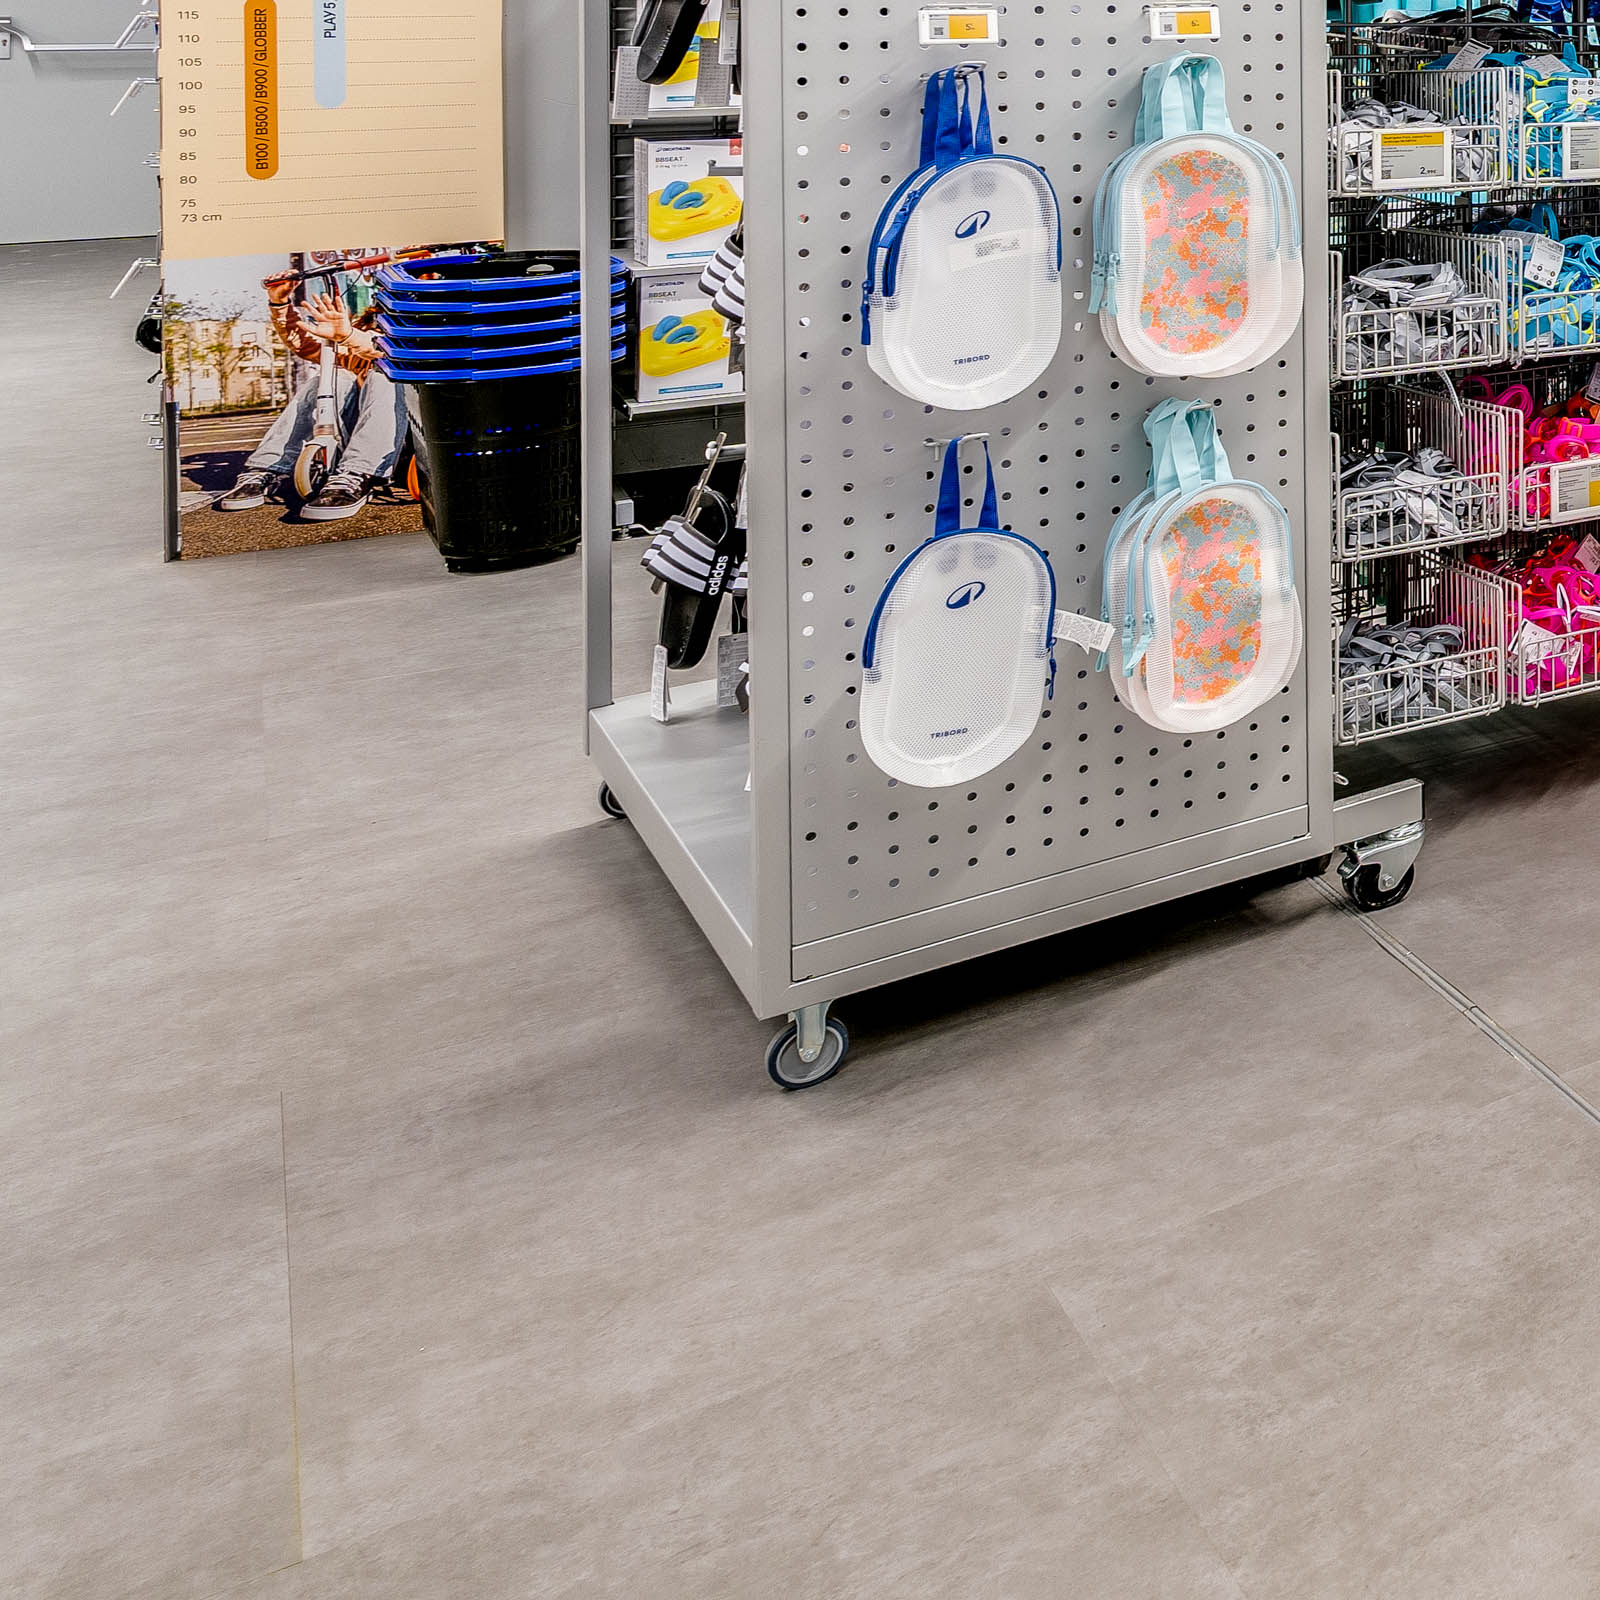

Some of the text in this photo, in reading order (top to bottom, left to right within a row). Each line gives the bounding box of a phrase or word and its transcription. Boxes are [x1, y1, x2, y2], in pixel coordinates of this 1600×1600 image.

[177, 11, 200, 20] 115
[177, 34, 200, 44] 110
[254, 8, 267, 62] GLOBBER
[177, 57, 202, 67] 105
[177, 81, 203, 91] 100
[179, 105, 197, 115] 95
[179, 128, 197, 138] 90
[179, 152, 197, 161] 85
[179, 175, 198, 185] 80
[180, 199, 197, 208] 75
[181, 213, 223, 223] 73 cm
[953, 354, 990, 365] TRIBORD
[708, 554, 729, 597] adidas
[930, 727, 968, 739] TRIBORD
